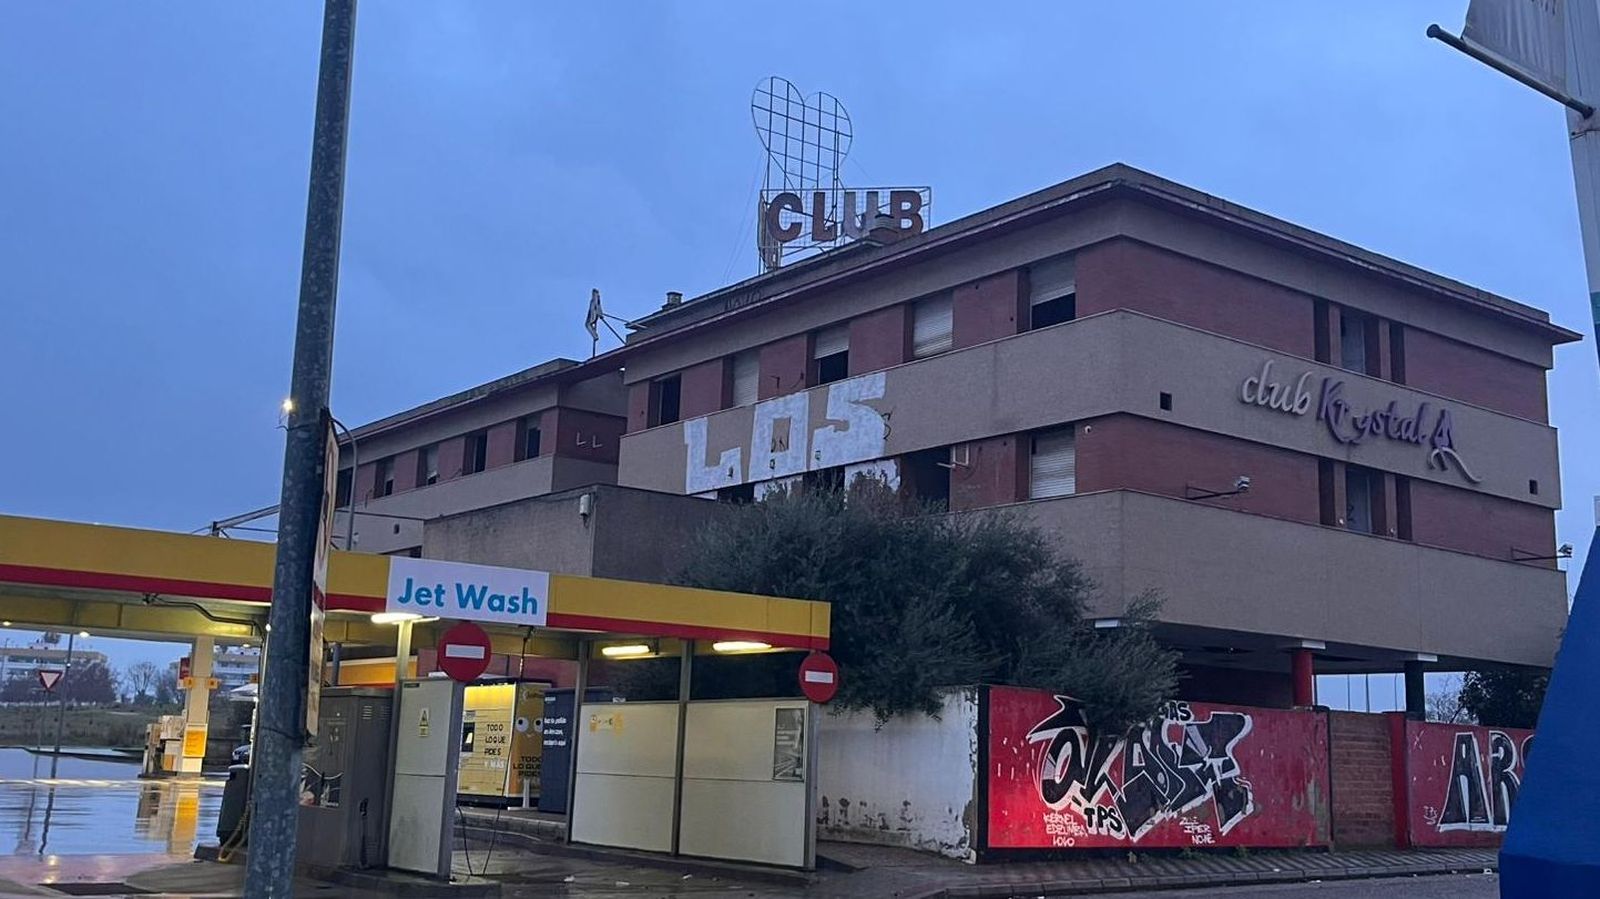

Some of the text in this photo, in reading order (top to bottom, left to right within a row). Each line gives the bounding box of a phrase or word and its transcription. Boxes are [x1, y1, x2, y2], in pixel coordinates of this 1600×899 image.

[767, 190, 923, 243] CLUB
[1240, 359, 1427, 444] club Krystal
[684, 372, 886, 495] LOS
[397, 577, 539, 616] Jet Wash
[486, 723, 504, 732] TODO
[1438, 730, 1535, 833] AR
[1083, 805, 1125, 836] TPS
